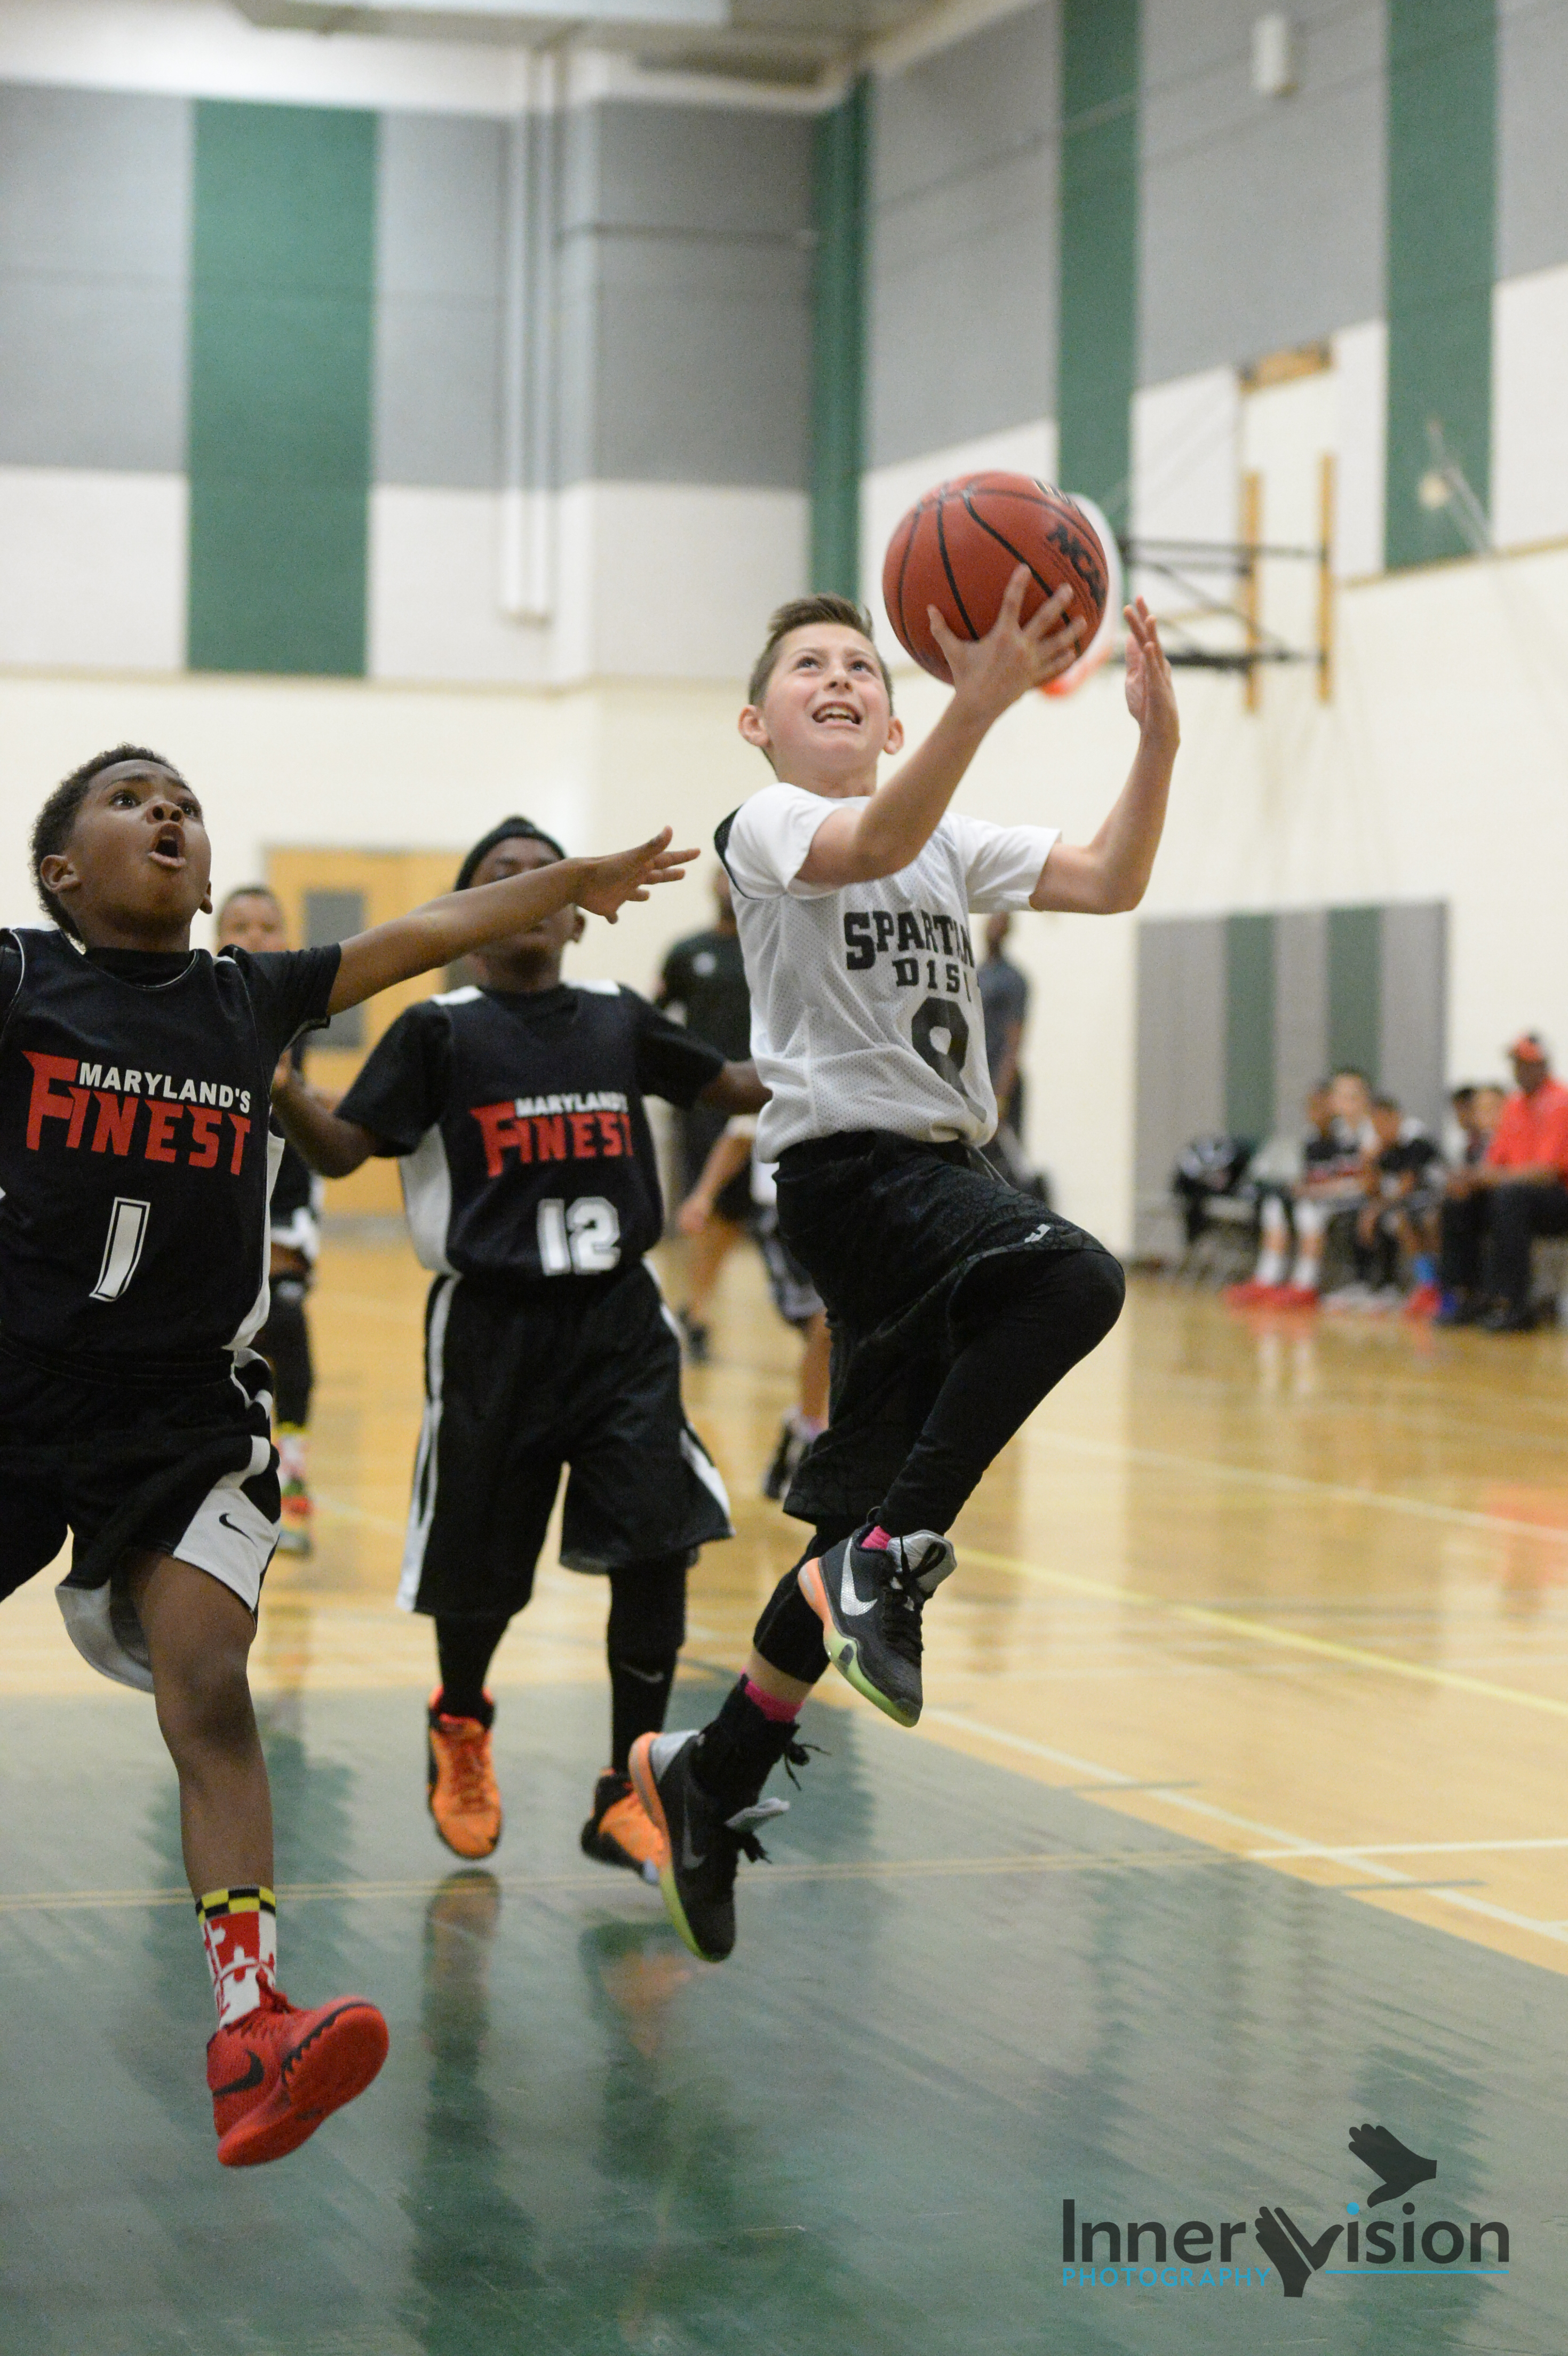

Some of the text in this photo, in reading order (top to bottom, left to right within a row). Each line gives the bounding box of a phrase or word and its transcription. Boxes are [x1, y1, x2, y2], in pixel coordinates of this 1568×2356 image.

[21, 1050, 251, 1176] FINEST
[78, 1062, 251, 1113] MARYLAND'S
[89, 1196, 150, 1302] 1
[536, 1196, 621, 1276] 12
